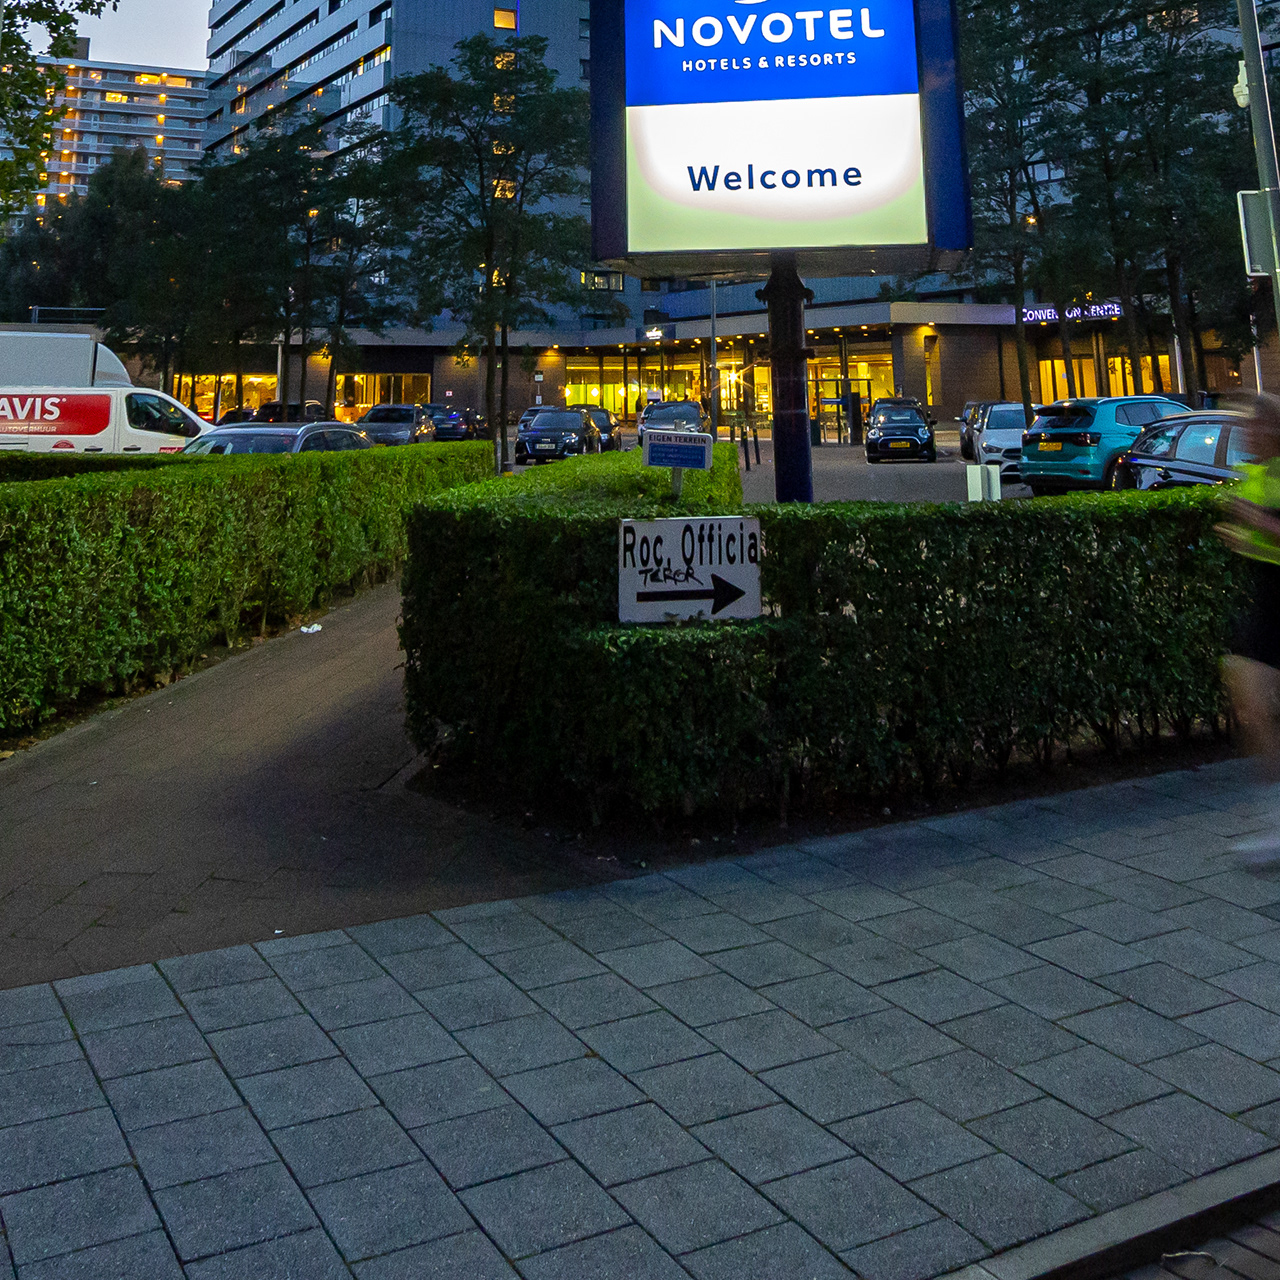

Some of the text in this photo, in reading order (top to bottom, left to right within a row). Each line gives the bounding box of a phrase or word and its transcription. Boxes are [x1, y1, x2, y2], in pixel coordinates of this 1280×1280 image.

[653, 7, 885, 49] NOVOTEL
[682, 51, 857, 72] HOTELS & RESORTS
[687, 164, 863, 192] Welcome
[649, 434, 707, 444] EIGEN TERREIN
[681, 522, 759, 567] Officia
